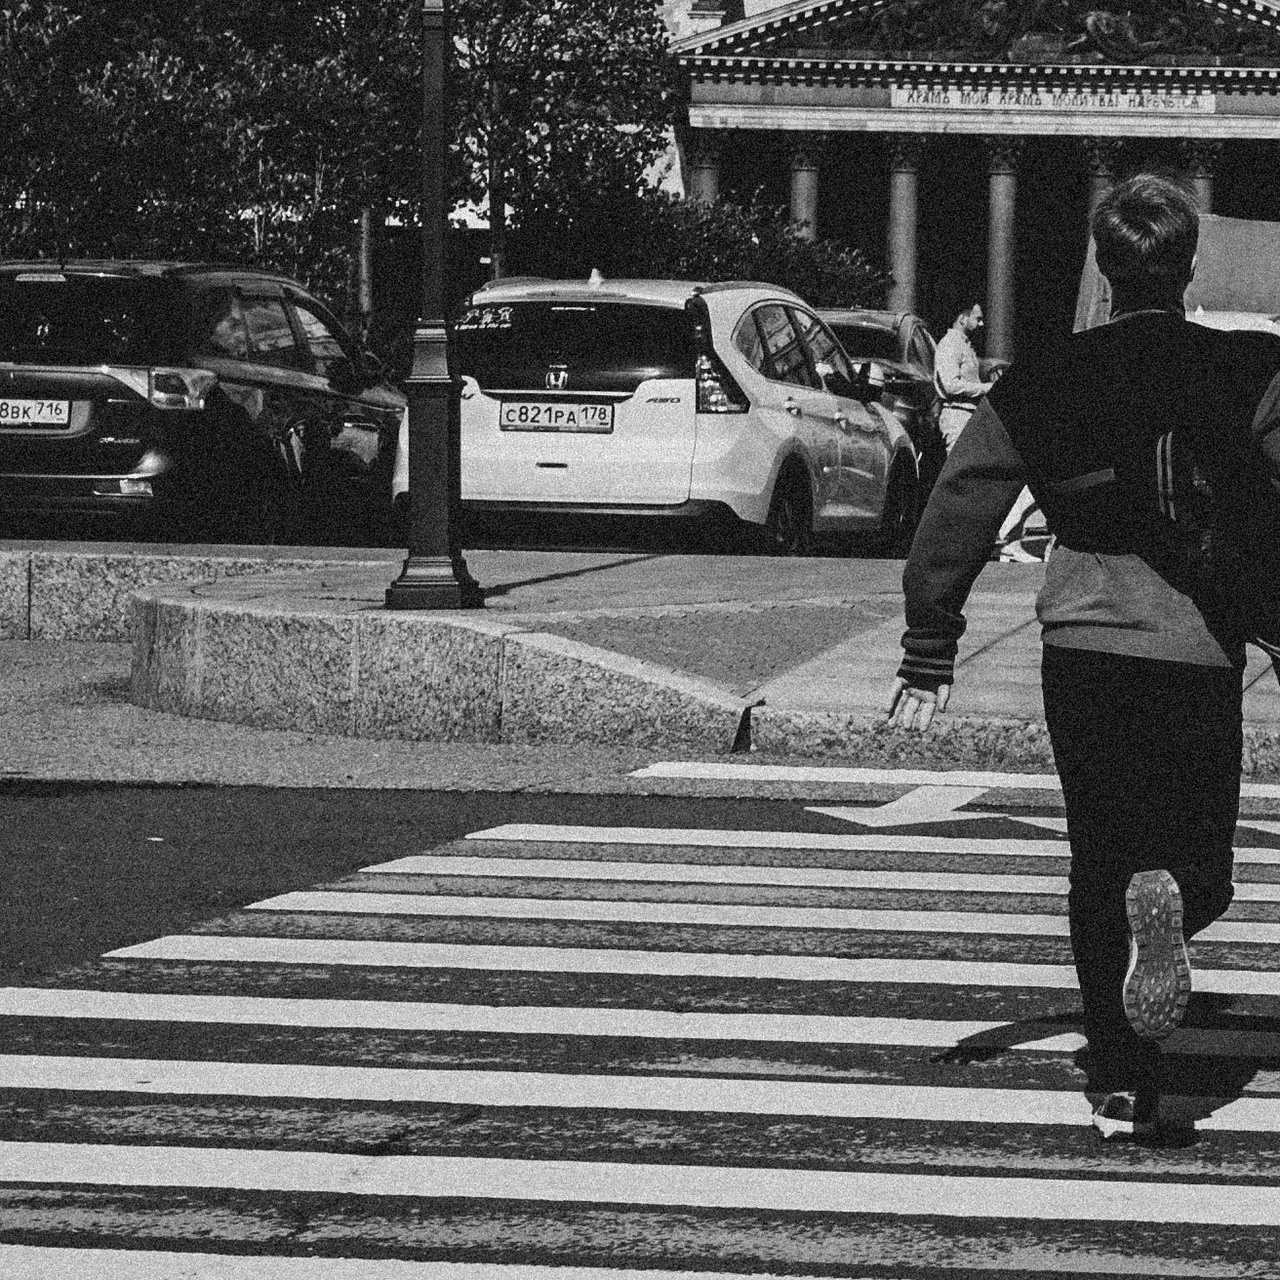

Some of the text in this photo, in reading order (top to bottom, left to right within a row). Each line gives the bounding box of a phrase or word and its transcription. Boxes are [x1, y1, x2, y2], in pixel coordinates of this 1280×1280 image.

[36, 402, 63, 416] 716
[505, 405, 608, 424] С821РА 178
